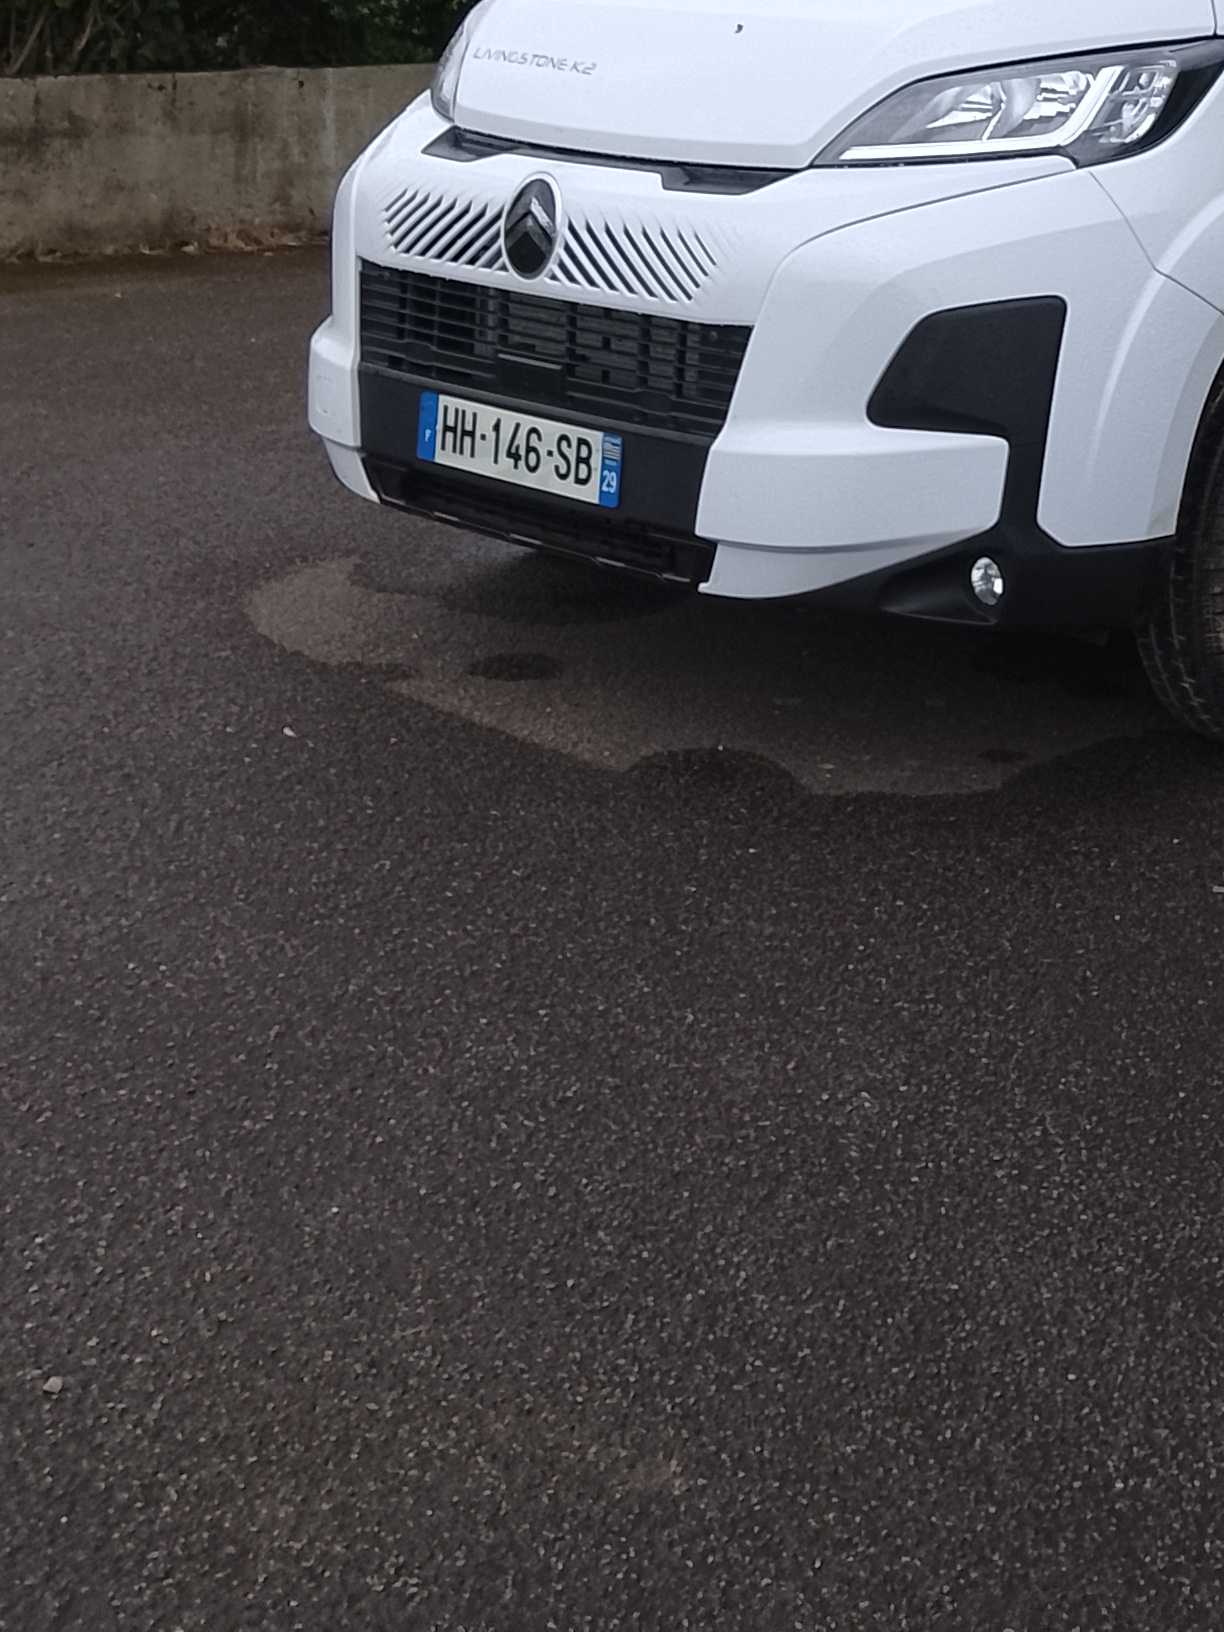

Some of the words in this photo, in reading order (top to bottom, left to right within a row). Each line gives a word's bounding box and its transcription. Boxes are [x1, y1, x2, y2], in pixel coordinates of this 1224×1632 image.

[472, 46, 568, 71] LIVINGSTONE
[569, 60, 597, 76] K2
[440, 404, 593, 486] HH-146-SB
[601, 469, 617, 494] 29
